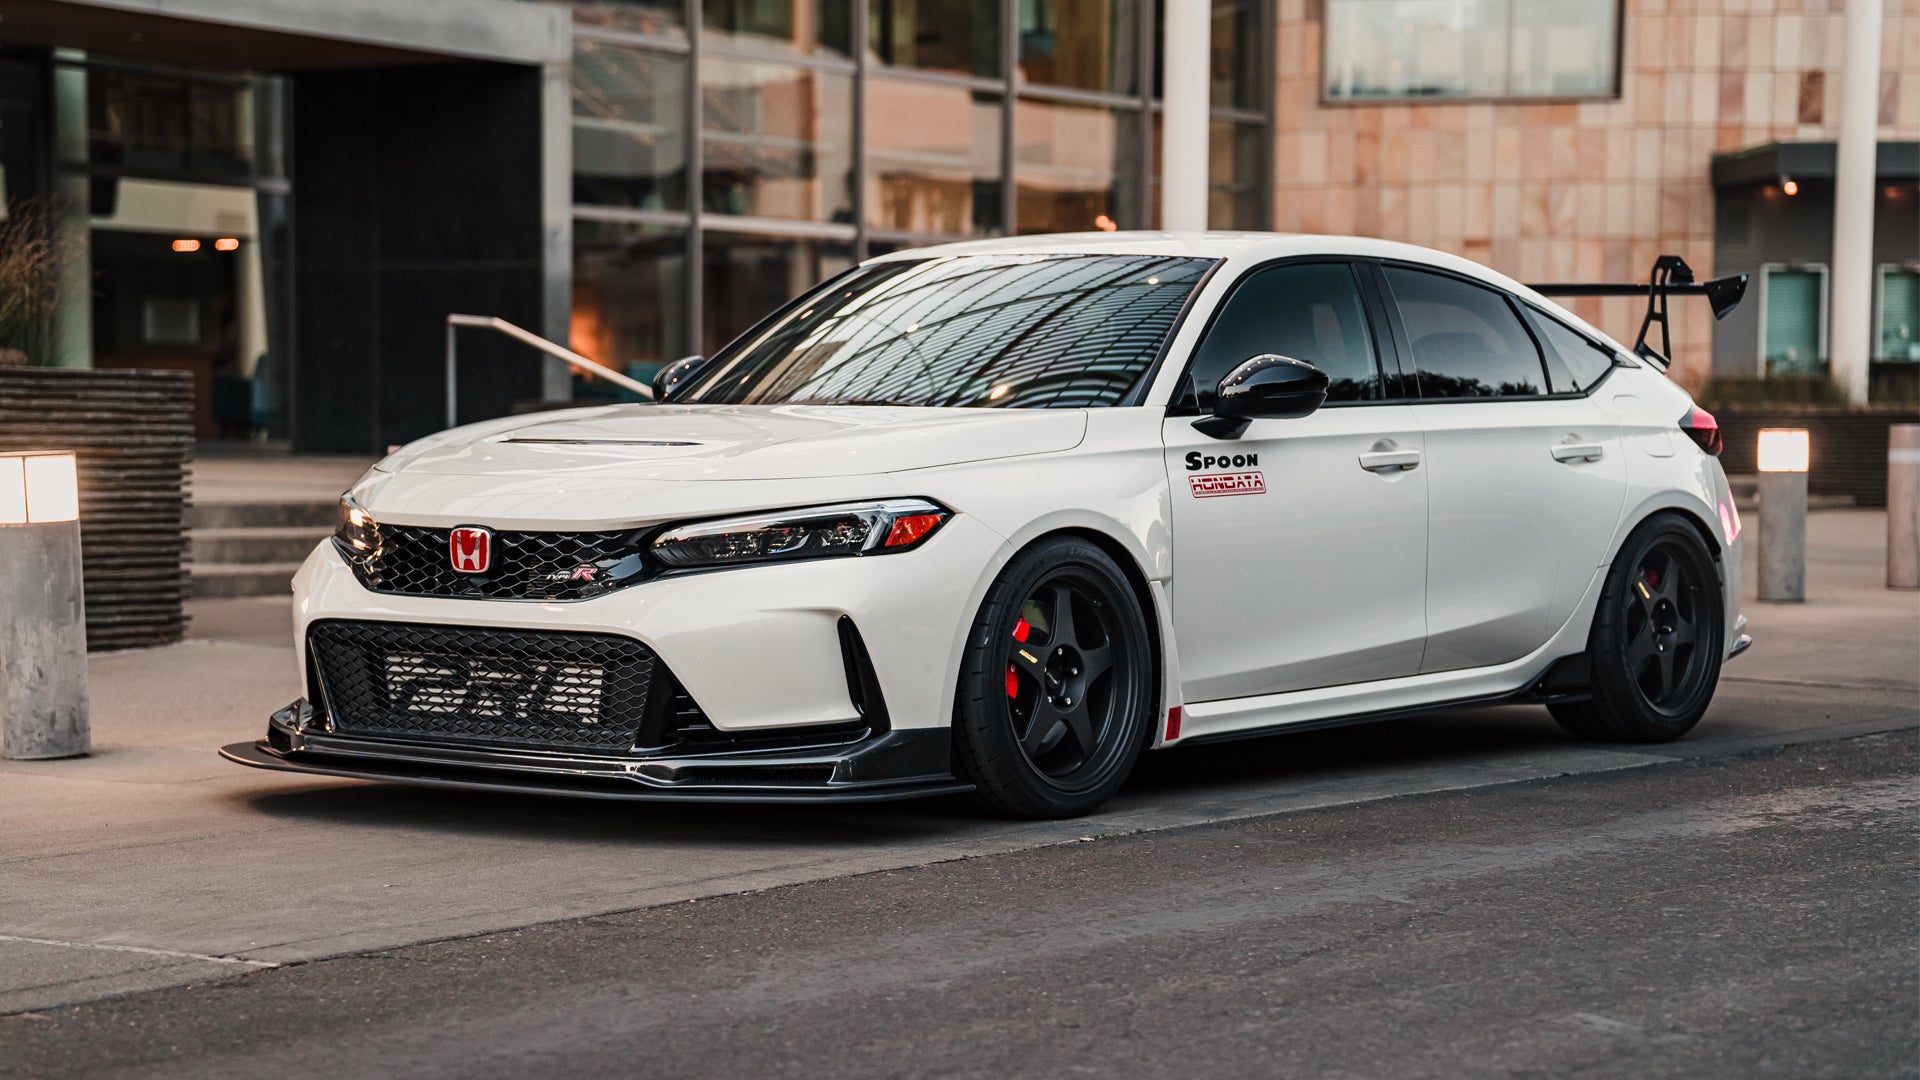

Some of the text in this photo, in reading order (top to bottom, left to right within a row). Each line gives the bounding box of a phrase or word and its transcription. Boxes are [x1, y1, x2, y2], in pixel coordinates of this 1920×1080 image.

[1185, 451, 1258, 471] SPOON
[1190, 474, 1264, 492] HONDATA
[570, 566, 597, 581] R
